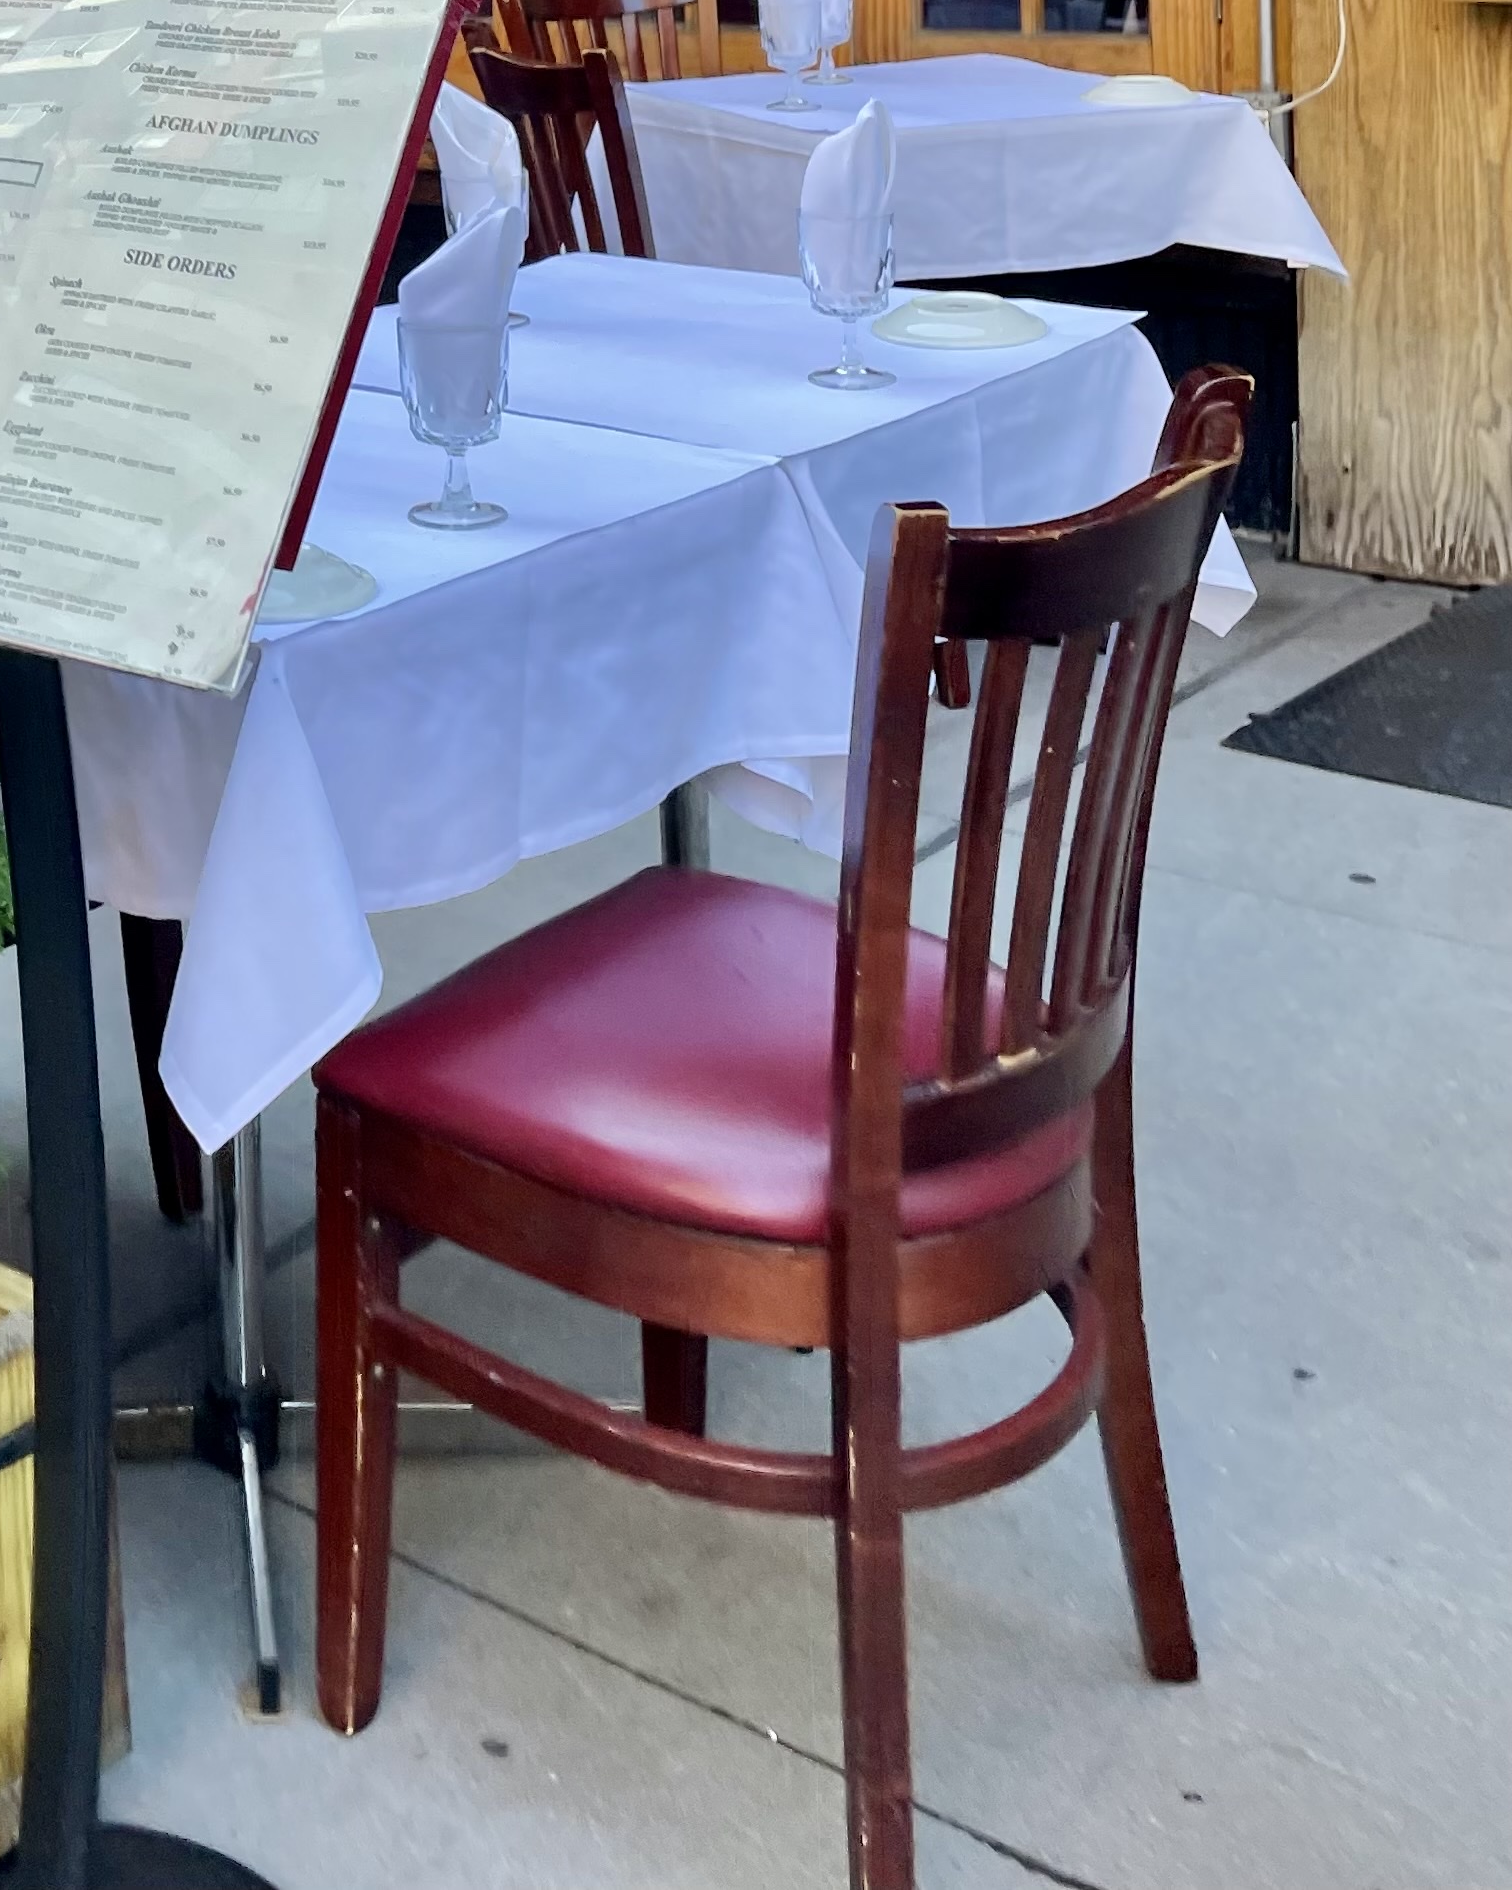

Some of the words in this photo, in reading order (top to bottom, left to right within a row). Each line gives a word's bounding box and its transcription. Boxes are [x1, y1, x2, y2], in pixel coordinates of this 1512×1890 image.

[146, 114, 218, 135] AFGHAN
[219, 122, 320, 145] DUMPLINGS
[123, 248, 164, 269] SIDE
[167, 256, 237, 279] ORDERS
